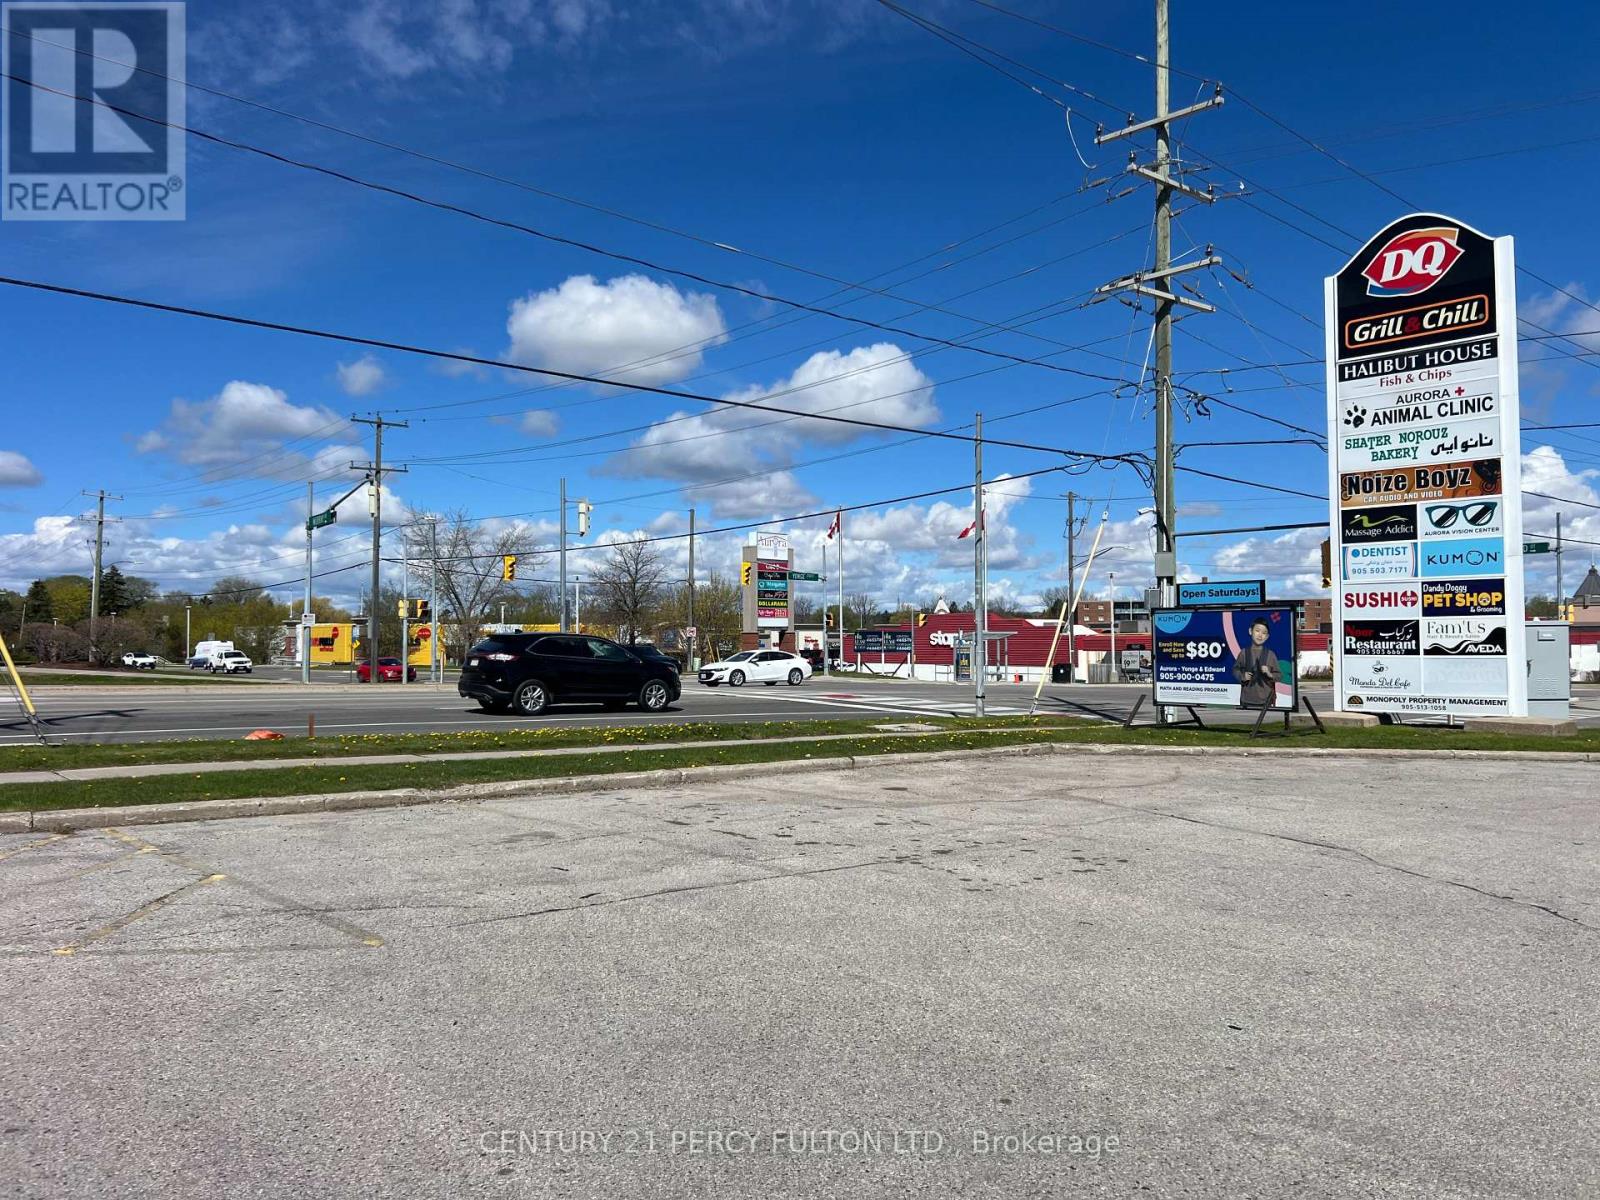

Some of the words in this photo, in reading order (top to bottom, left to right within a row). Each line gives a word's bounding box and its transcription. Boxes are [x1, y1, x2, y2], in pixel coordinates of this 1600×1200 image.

[1379, 241, 1447, 283] DQ
[1353, 315, 1403, 342] Grill
[1422, 301, 1479, 329] Chill
[1344, 354, 1420, 379] HALIBUT
[1425, 342, 1493, 366] HOUSE
[1379, 372, 1402, 388] Fish
[1405, 373, 1415, 384] &
[1418, 367, 1453, 382] Chips
[1395, 388, 1451, 405] AURORA
[1371, 405, 1433, 427] ANIMAL
[1437, 396, 1494, 418] CLINIC
[1345, 434, 1392, 451] SHATER
[1398, 427, 1449, 445] NOROUZ
[1371, 446, 1420, 462] BAKERY
[1347, 473, 1408, 497] Noize
[1414, 466, 1472, 491] Boyz
[1380, 492, 1402, 502] AUDIO
[1404, 491, 1418, 500] AND
[1421, 489, 1443, 498] VIDEO
[1345, 526, 1382, 538] Massage
[1385, 524, 1414, 535] Addict
[1361, 546, 1408, 557] DENTIST
[1427, 550, 1499, 566] KUMON
[1182, 590, 1206, 599] Open
[1208, 587, 1259, 597] Saturdays!
[1423, 583, 1445, 594] Dandy
[1445, 582, 1467, 593] Doggy
[1344, 592, 1398, 608] SUSHI
[1423, 593, 1453, 608] PET
[1455, 591, 1503, 607] SHOP
[1158, 614, 1187, 623] KUMON
[1345, 636, 1417, 650] Restaurant
[1465, 644, 1504, 654] AVEDA
[1160, 672, 1215, 681] 905-900-0475
[1366, 696, 1407, 704] MONOPOLY
[1408, 697, 1447, 705] PROPERTY
[1448, 698, 1507, 706] MANAGEMENT
